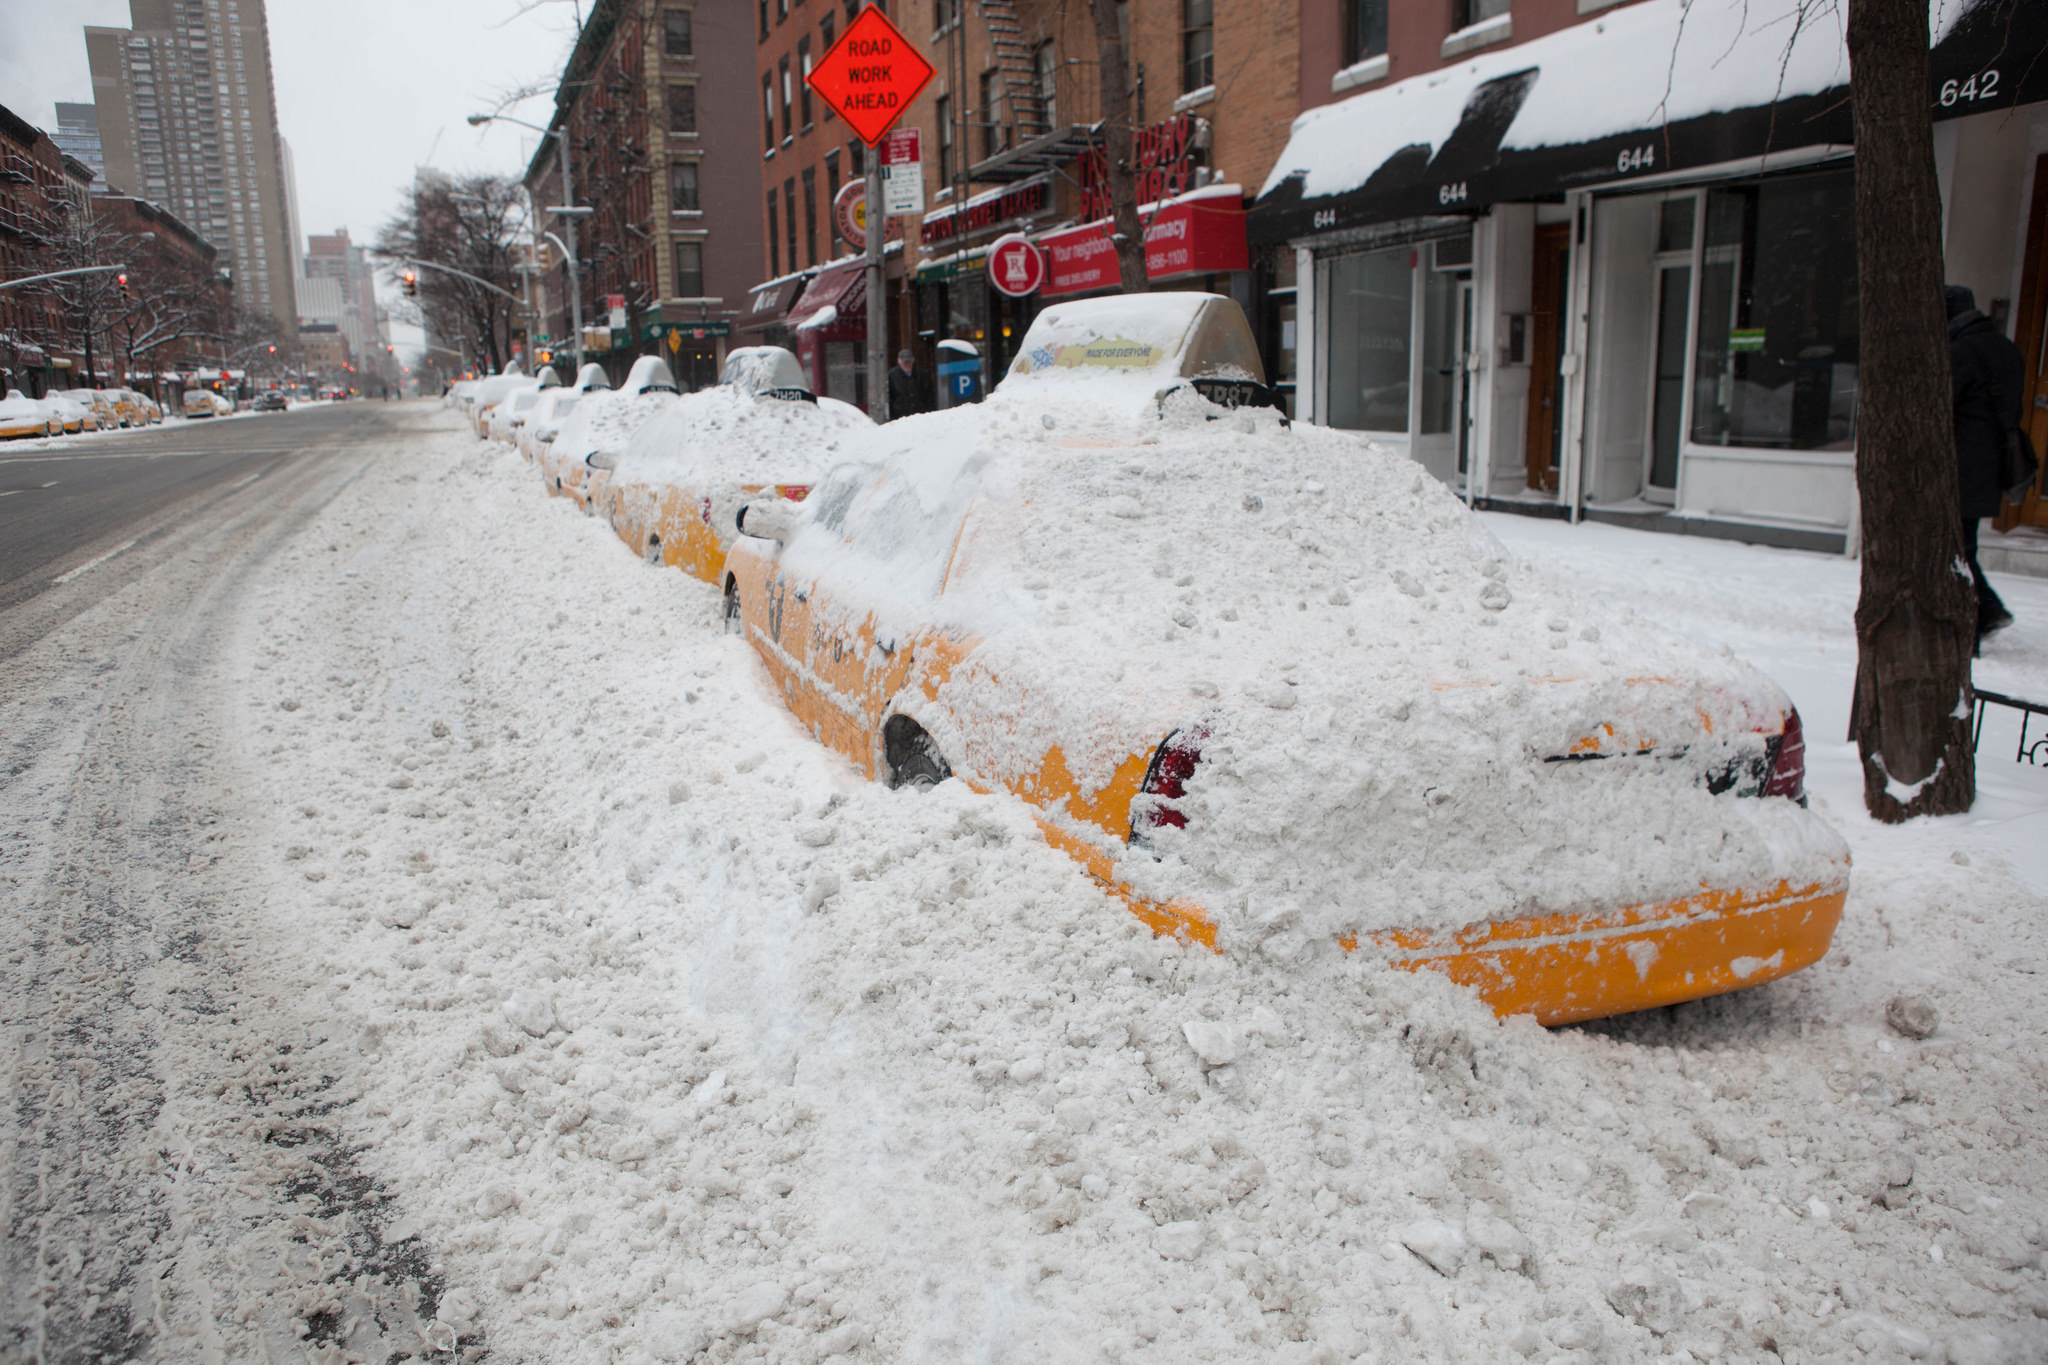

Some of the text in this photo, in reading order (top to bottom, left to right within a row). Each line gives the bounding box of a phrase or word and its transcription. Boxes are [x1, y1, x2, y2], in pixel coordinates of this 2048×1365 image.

[848, 39, 892, 56] ROAD
[848, 65, 892, 83] WORK
[1940, 69, 2000, 107] 642
[843, 92, 898, 110] AHEAD
[1617, 144, 1655, 173] 644
[1439, 181, 1467, 205] 644
[1314, 208, 1336, 228] 644
[1143, 218, 1188, 243] armacy
[1087, 346, 1152, 358] MADE FOR EVERYONE
[959, 375, 971, 394] P
